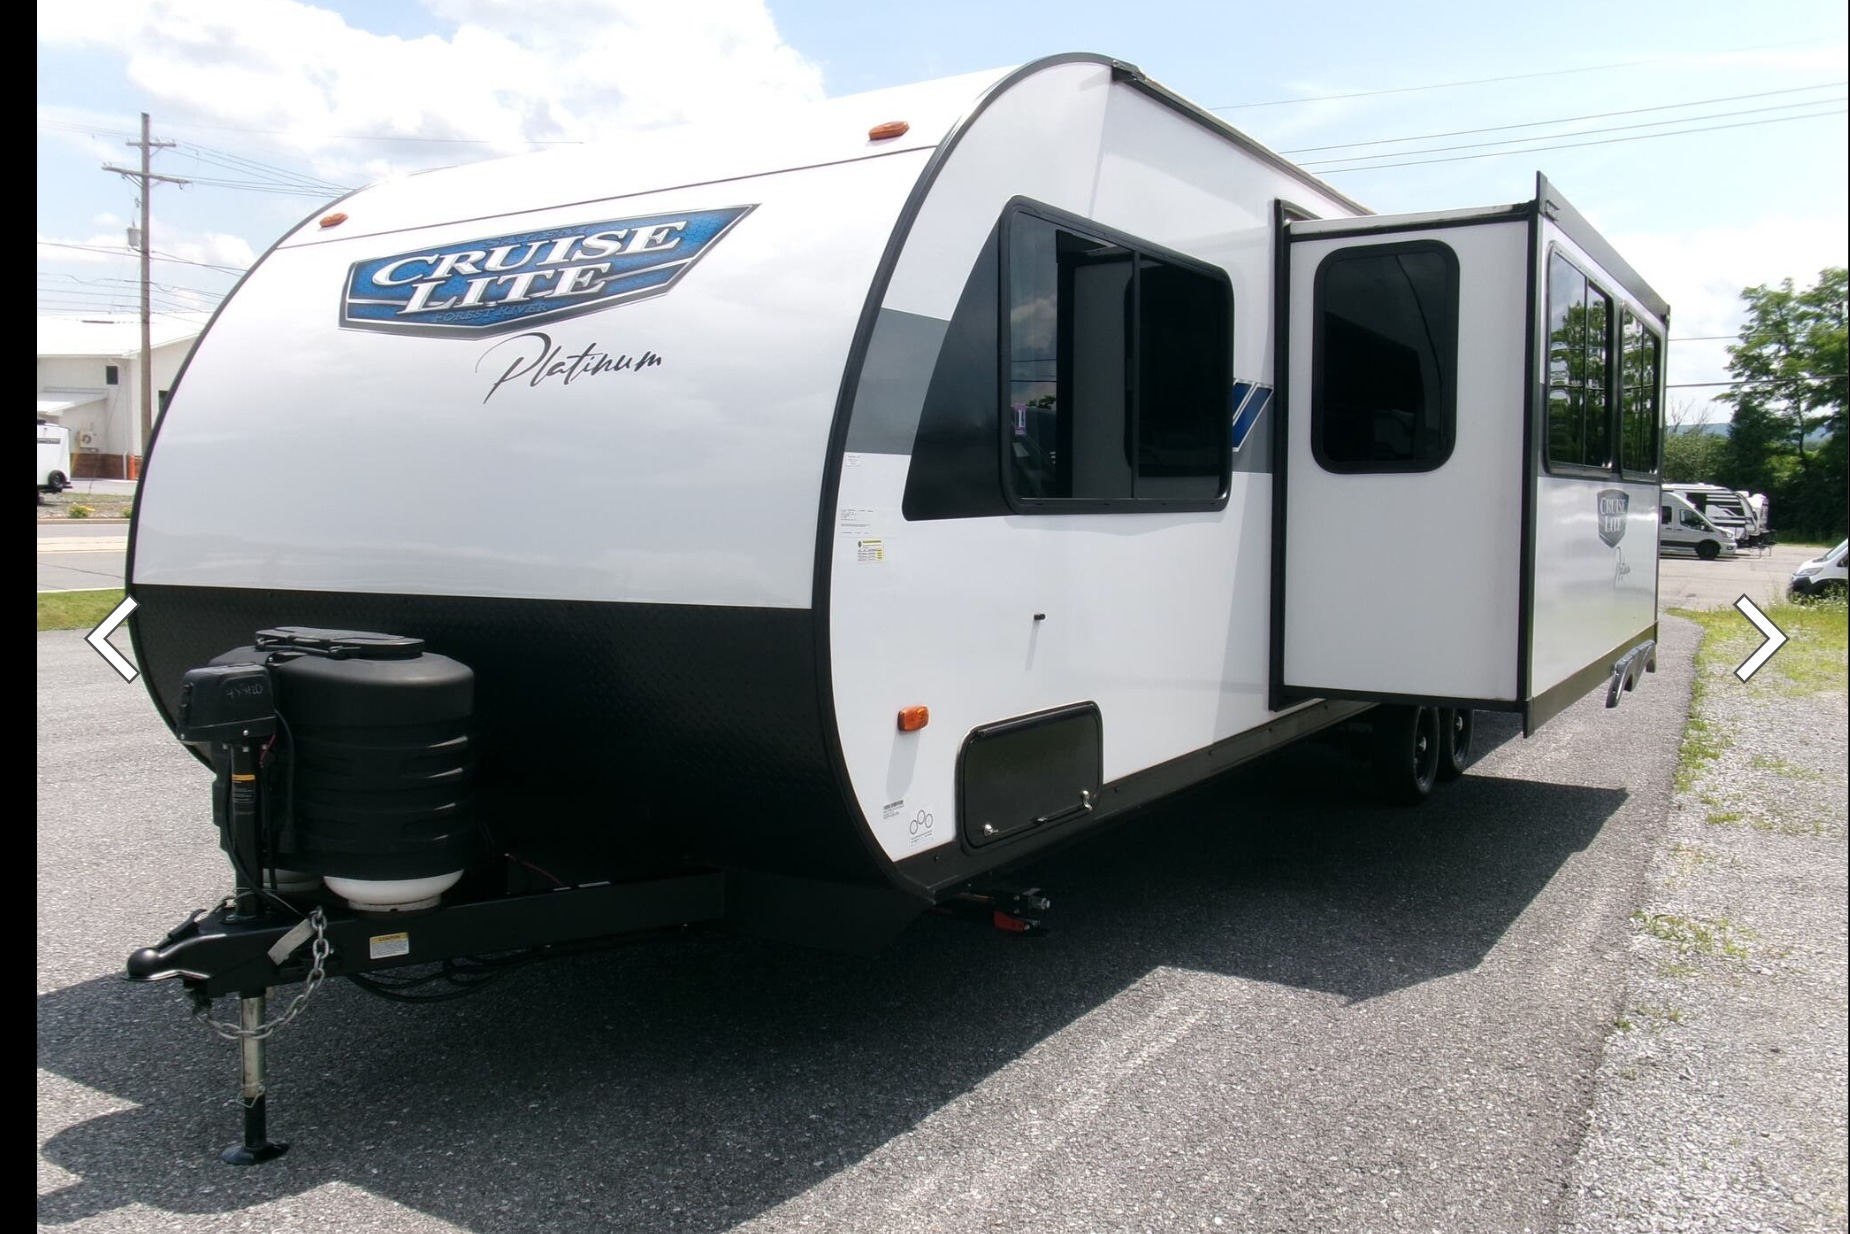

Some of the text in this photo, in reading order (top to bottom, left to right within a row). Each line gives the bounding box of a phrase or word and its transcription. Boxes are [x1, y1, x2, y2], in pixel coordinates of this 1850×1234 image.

[371, 220, 687, 287] CRUISE
[396, 261, 613, 316] LITE
[433, 302, 548, 323] FOREST RIVER
[474, 331, 663, 405] Platinum
[1600, 498, 1626, 515] CRUISE
[1605, 516, 1621, 532] LITE
